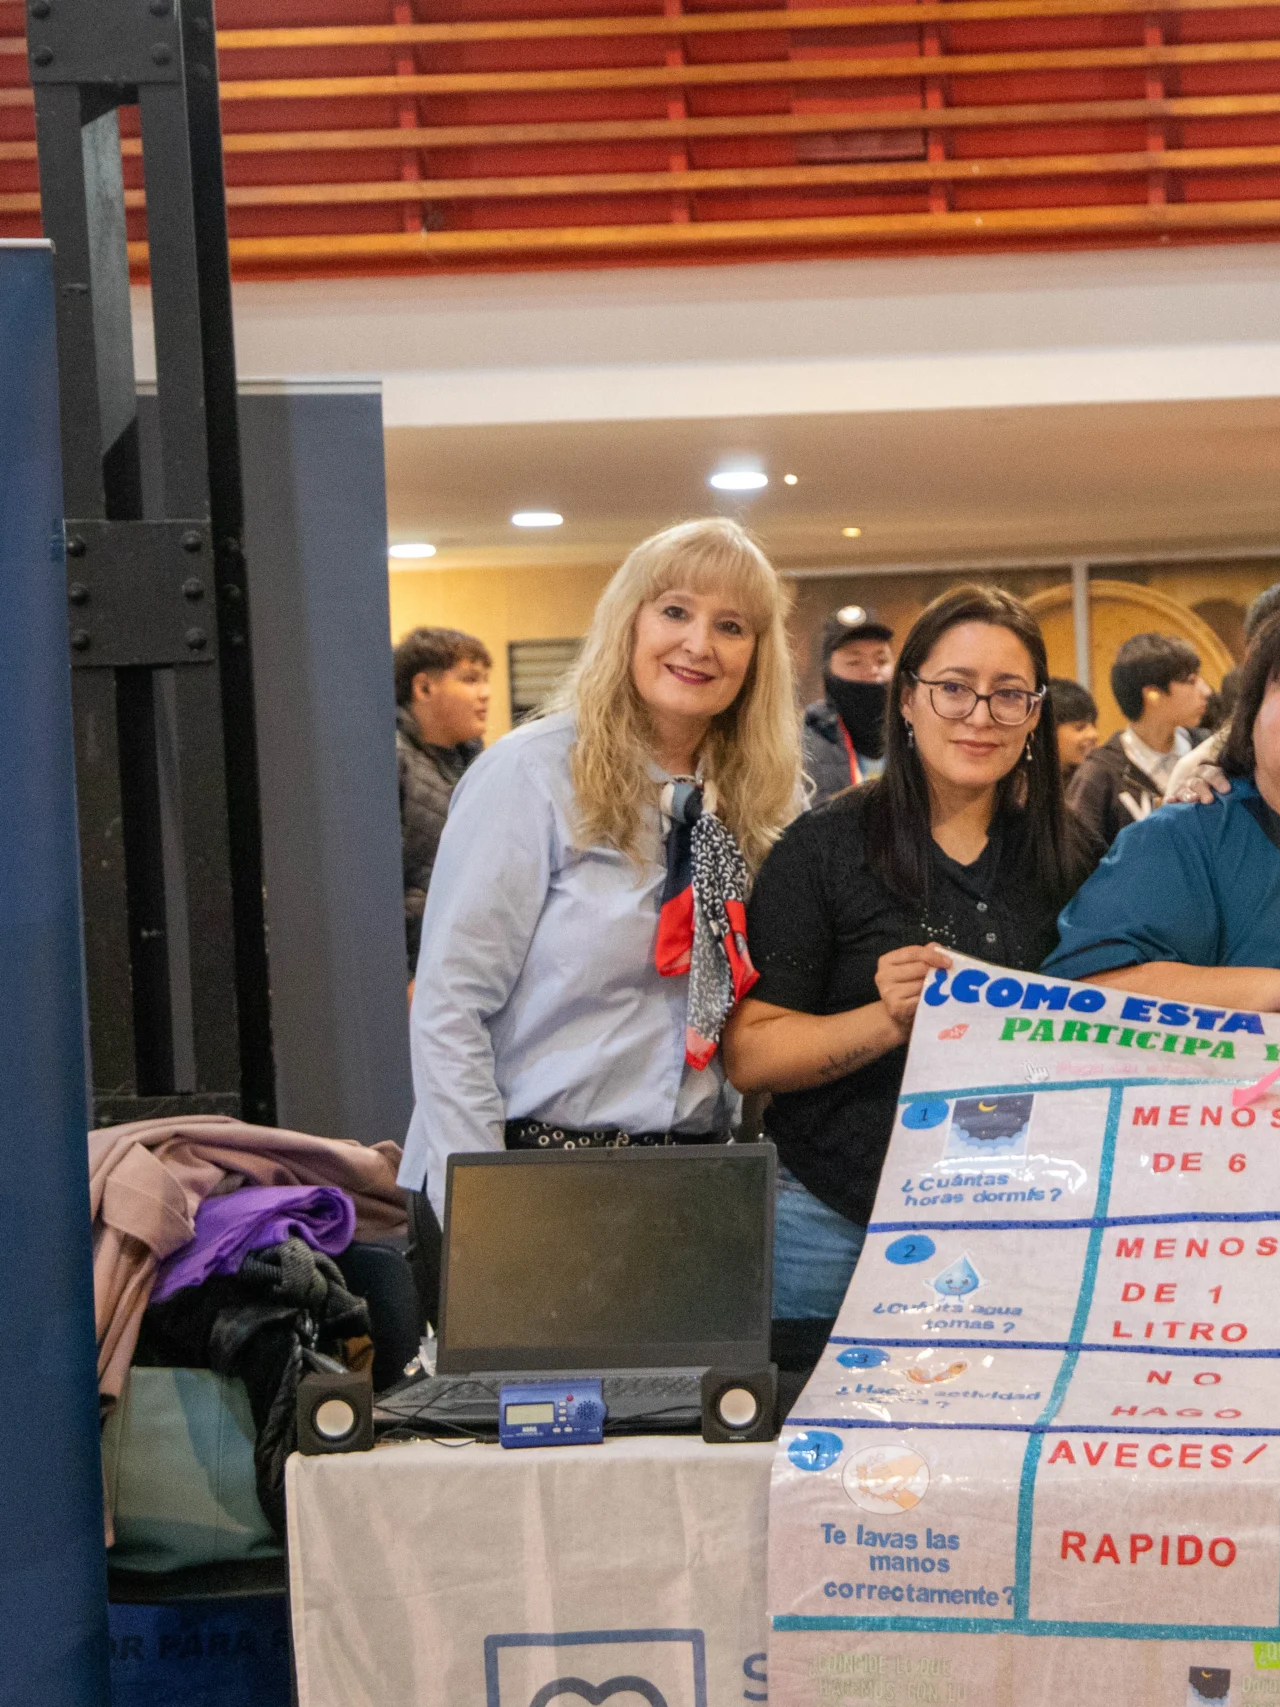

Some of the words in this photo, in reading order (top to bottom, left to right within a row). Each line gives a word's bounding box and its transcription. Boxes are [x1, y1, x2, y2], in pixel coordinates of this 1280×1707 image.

[1119, 996, 1264, 1036] ESTA
[999, 1016, 1235, 1060] PARTICIPA
[1152, 1152, 1202, 1173] DE
[1227, 1152, 1247, 1174] 6
[904, 1193, 964, 1206] horas
[903, 1244, 916, 1258] 2
[1115, 1236, 1278, 1259] MENOS
[1120, 1282, 1177, 1304] DE
[1210, 1285, 1222, 1305] 1
[970, 1303, 1023, 1316] agua
[925, 1318, 995, 1331] tomas
[1112, 1320, 1248, 1343] LITRO
[1146, 1369, 1222, 1386] NO
[1112, 1405, 1242, 1419] HAGO
[820, 1523, 847, 1544] Te
[857, 1525, 917, 1549] lavas
[926, 1529, 961, 1550] las
[1059, 1529, 1238, 1569] RAPIDO
[870, 1556, 949, 1572] manos
[823, 1581, 1015, 1606] correctamente?
